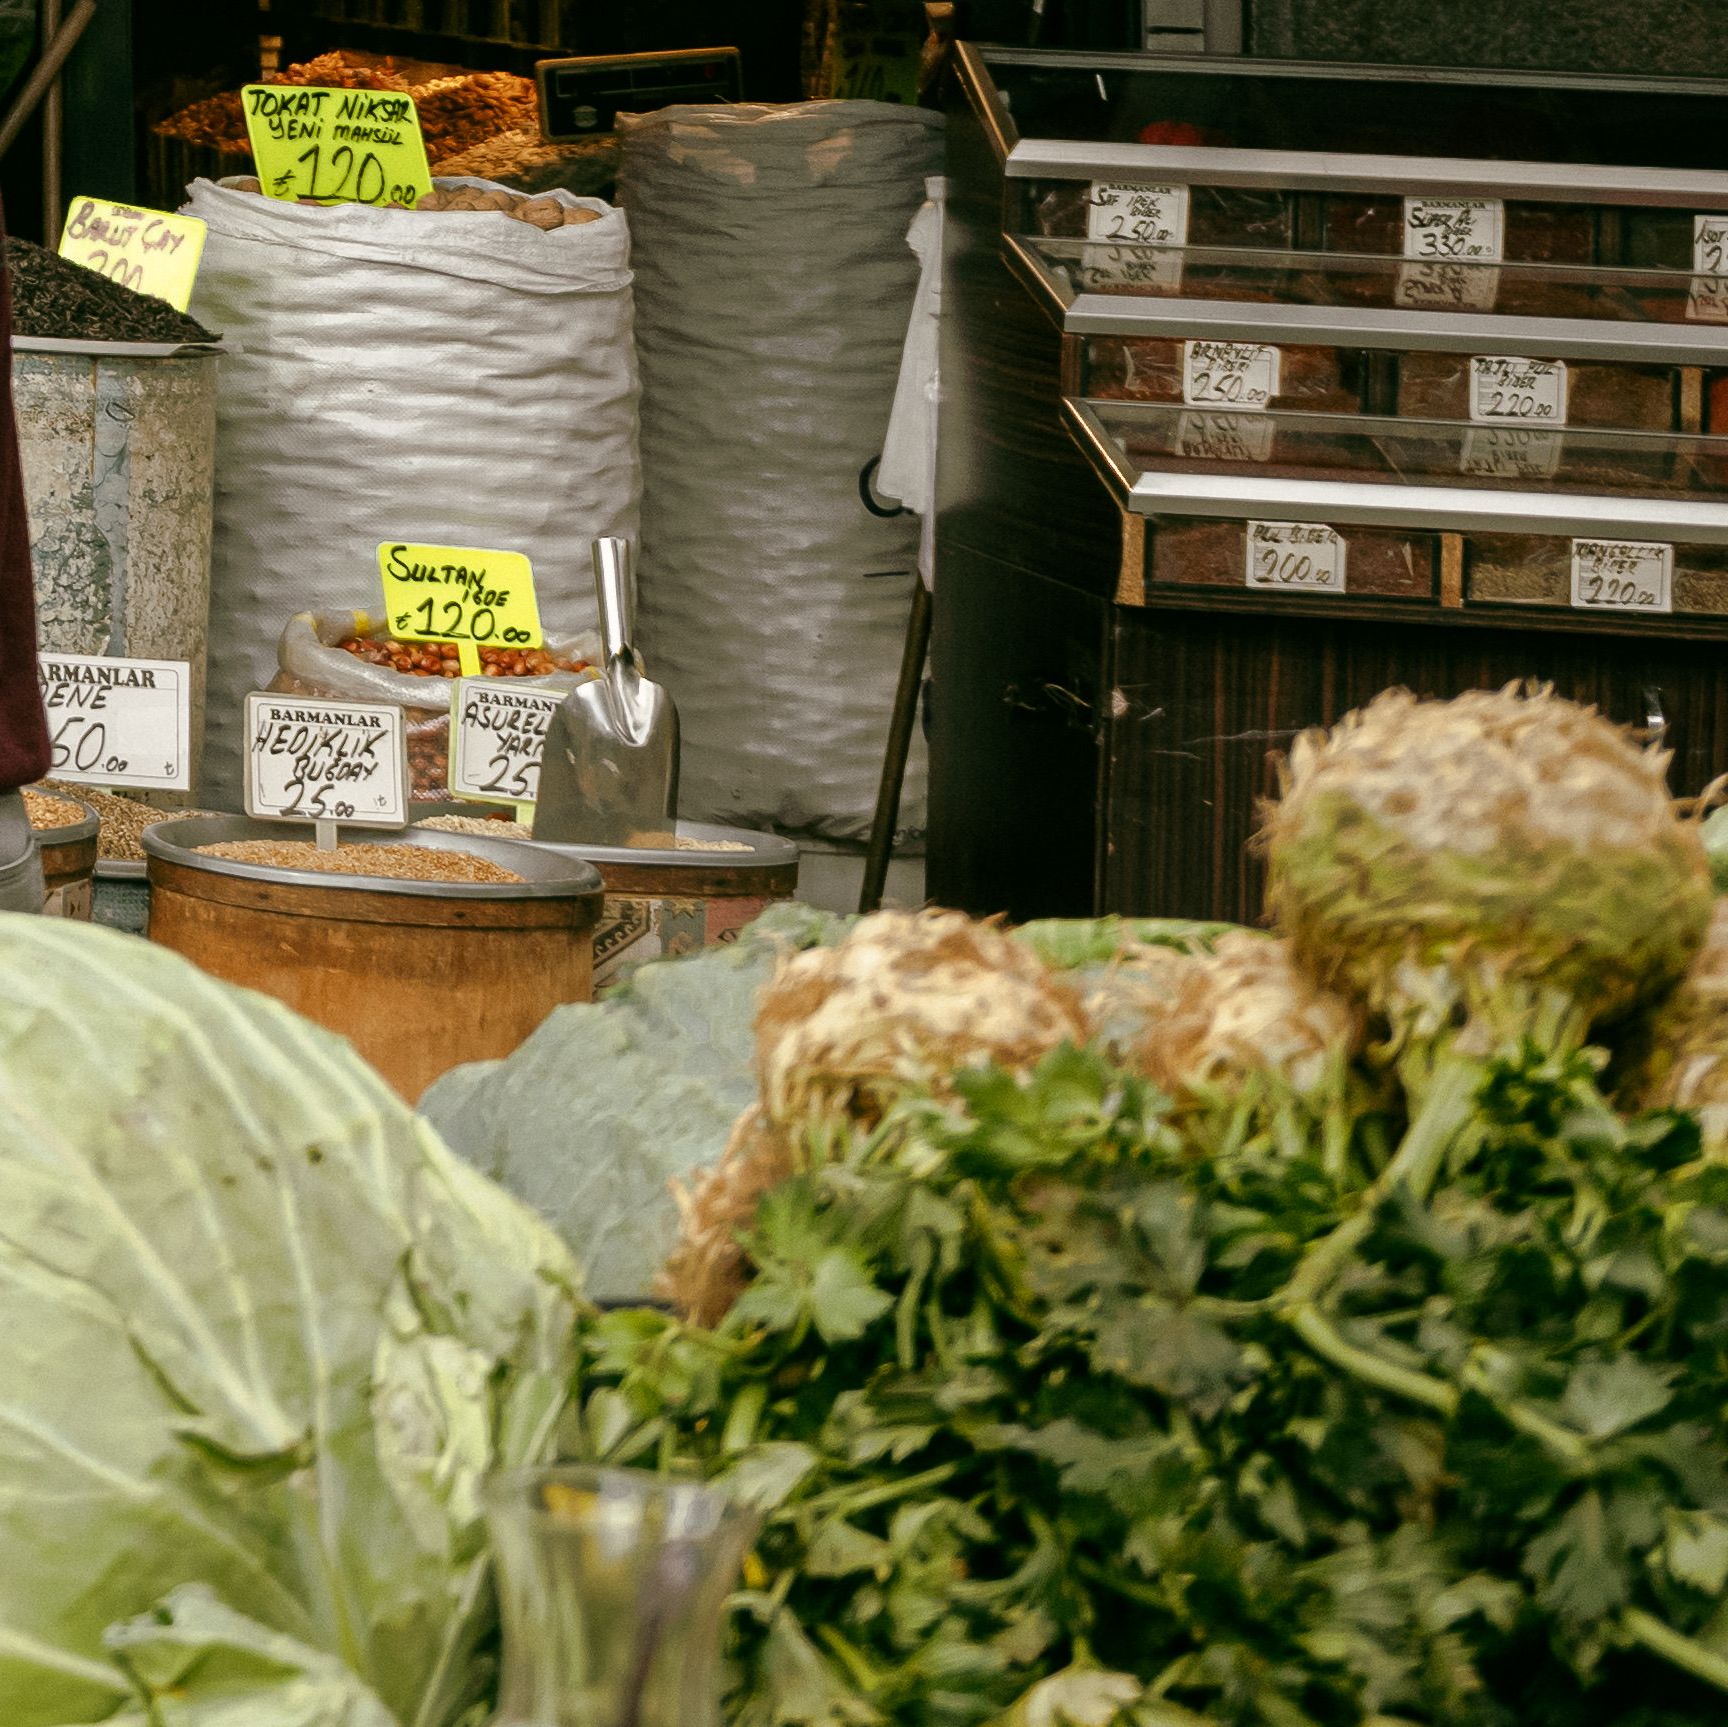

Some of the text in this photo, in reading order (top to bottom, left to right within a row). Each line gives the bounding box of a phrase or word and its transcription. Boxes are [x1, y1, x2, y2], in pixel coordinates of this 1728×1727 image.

[248, 89, 330, 117] TOKAT
[387, 545, 486, 589] SULTAN
[39, 664, 156, 688] RMANLAR
[270, 708, 381, 728] BARMANLAR
[279, 779, 355, 818] 25.00
